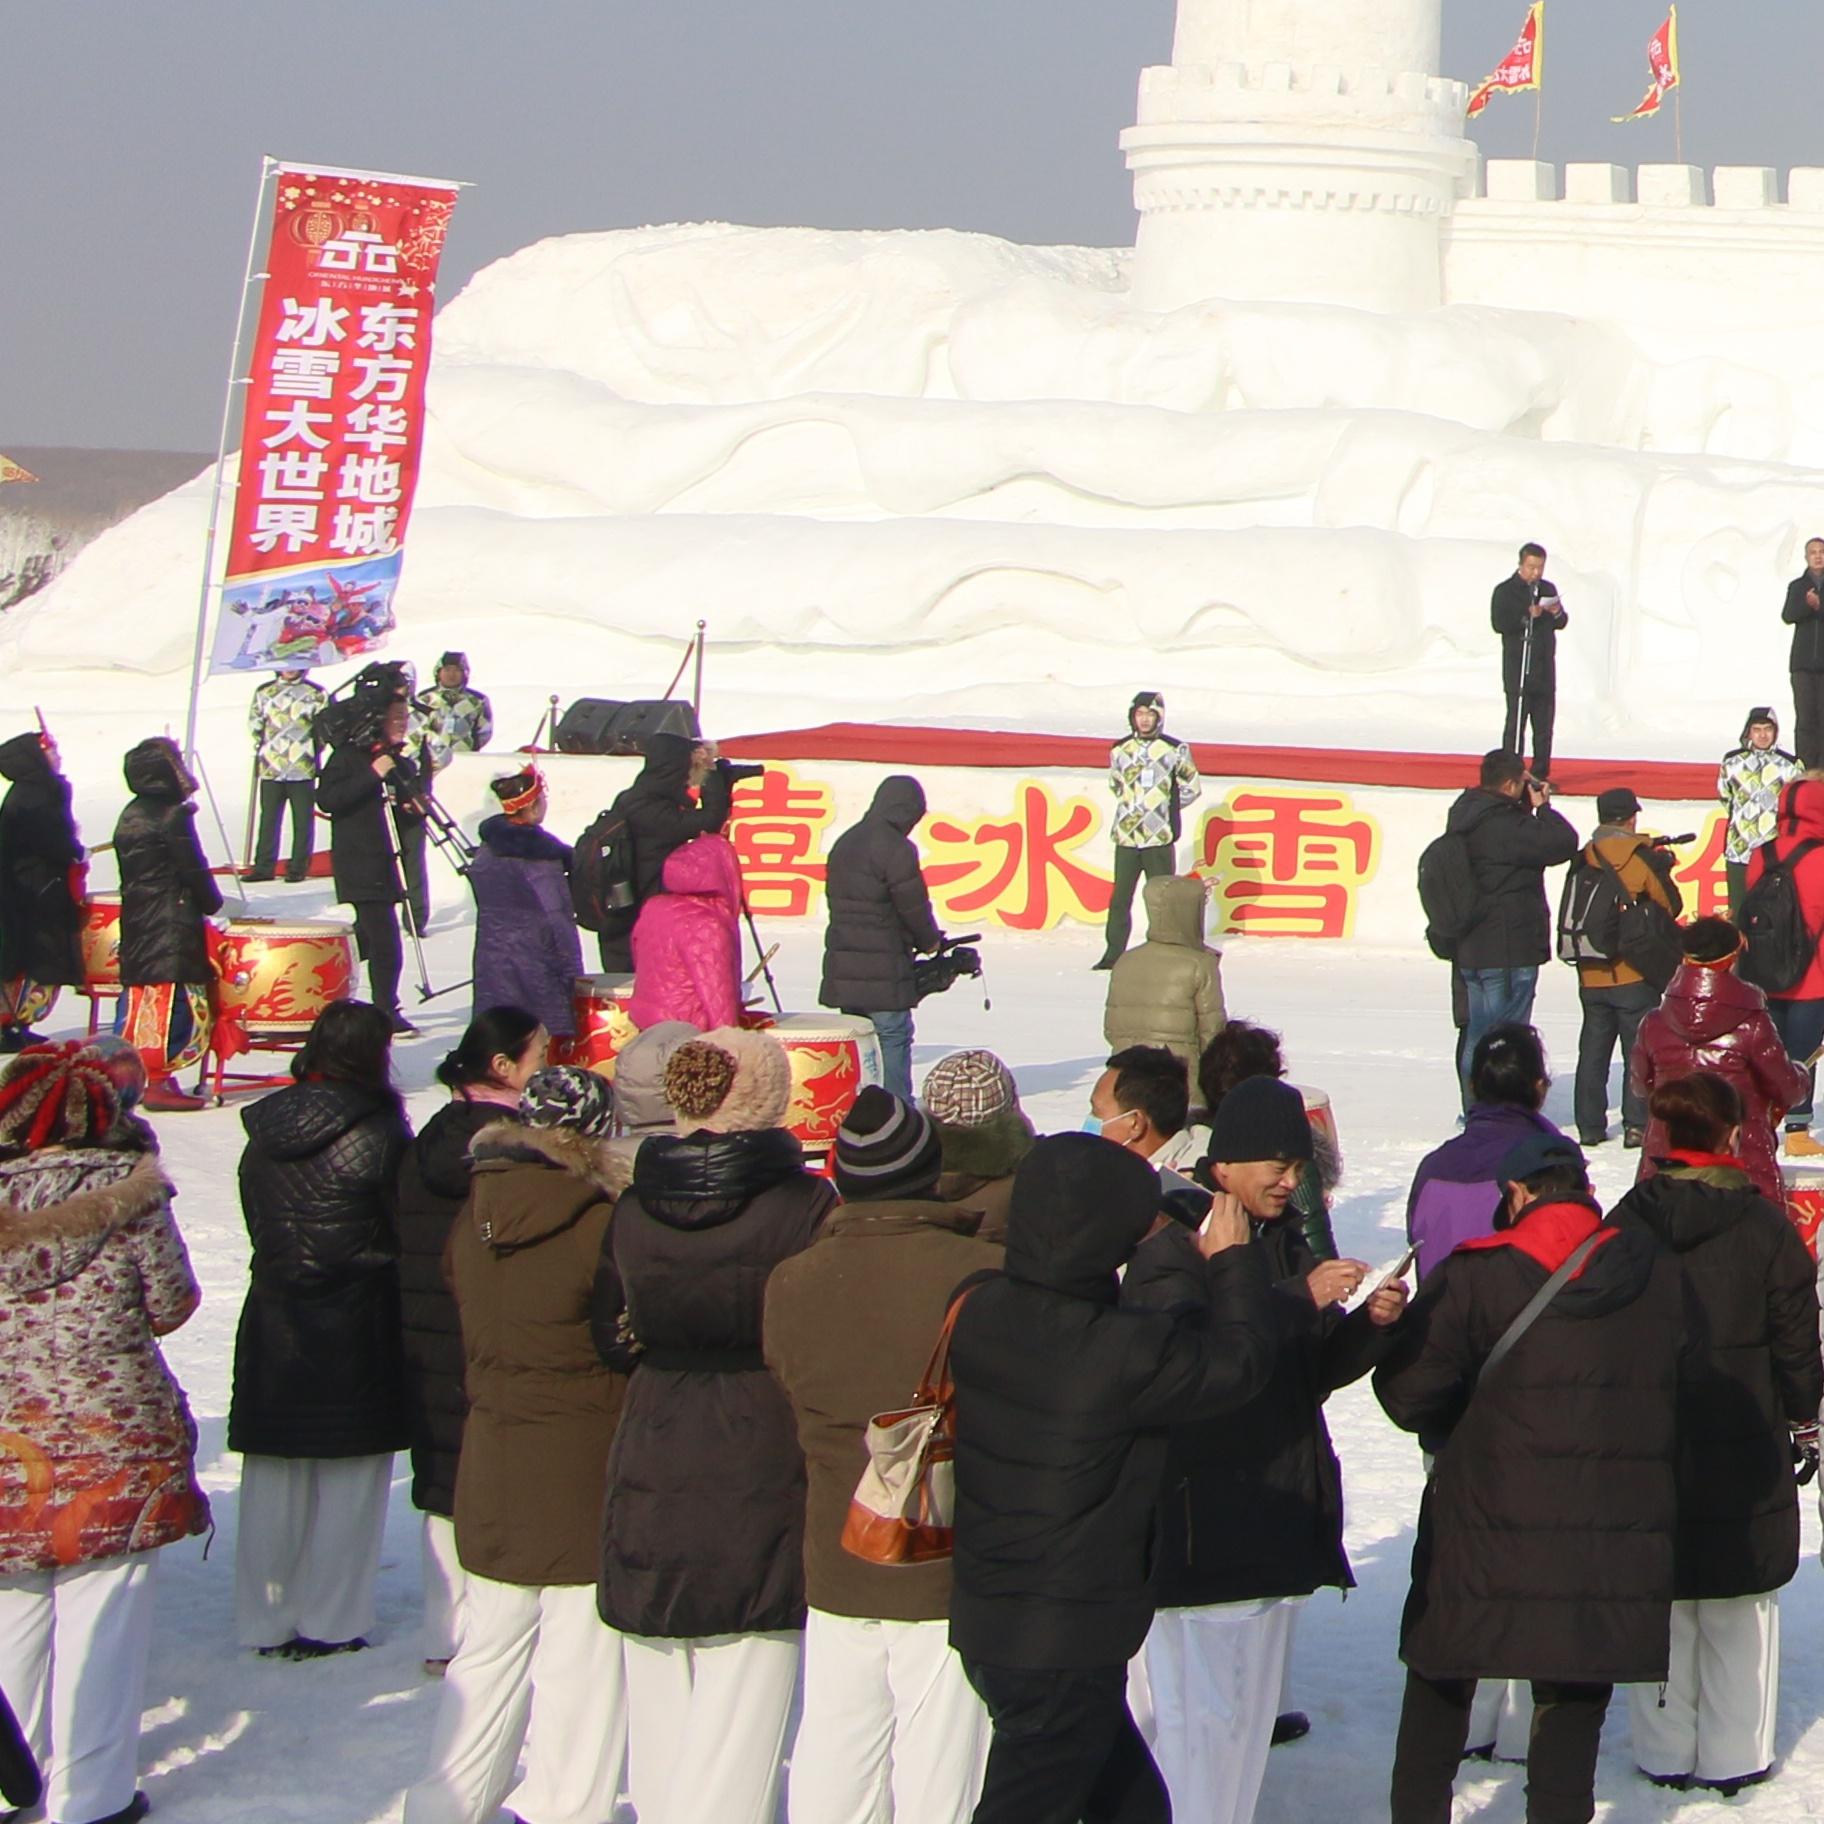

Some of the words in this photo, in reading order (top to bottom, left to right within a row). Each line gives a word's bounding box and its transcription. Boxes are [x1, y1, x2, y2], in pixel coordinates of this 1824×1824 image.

[250, 297, 351, 554] 冰雪大世界
[330, 302, 420, 556] 东方华地城
